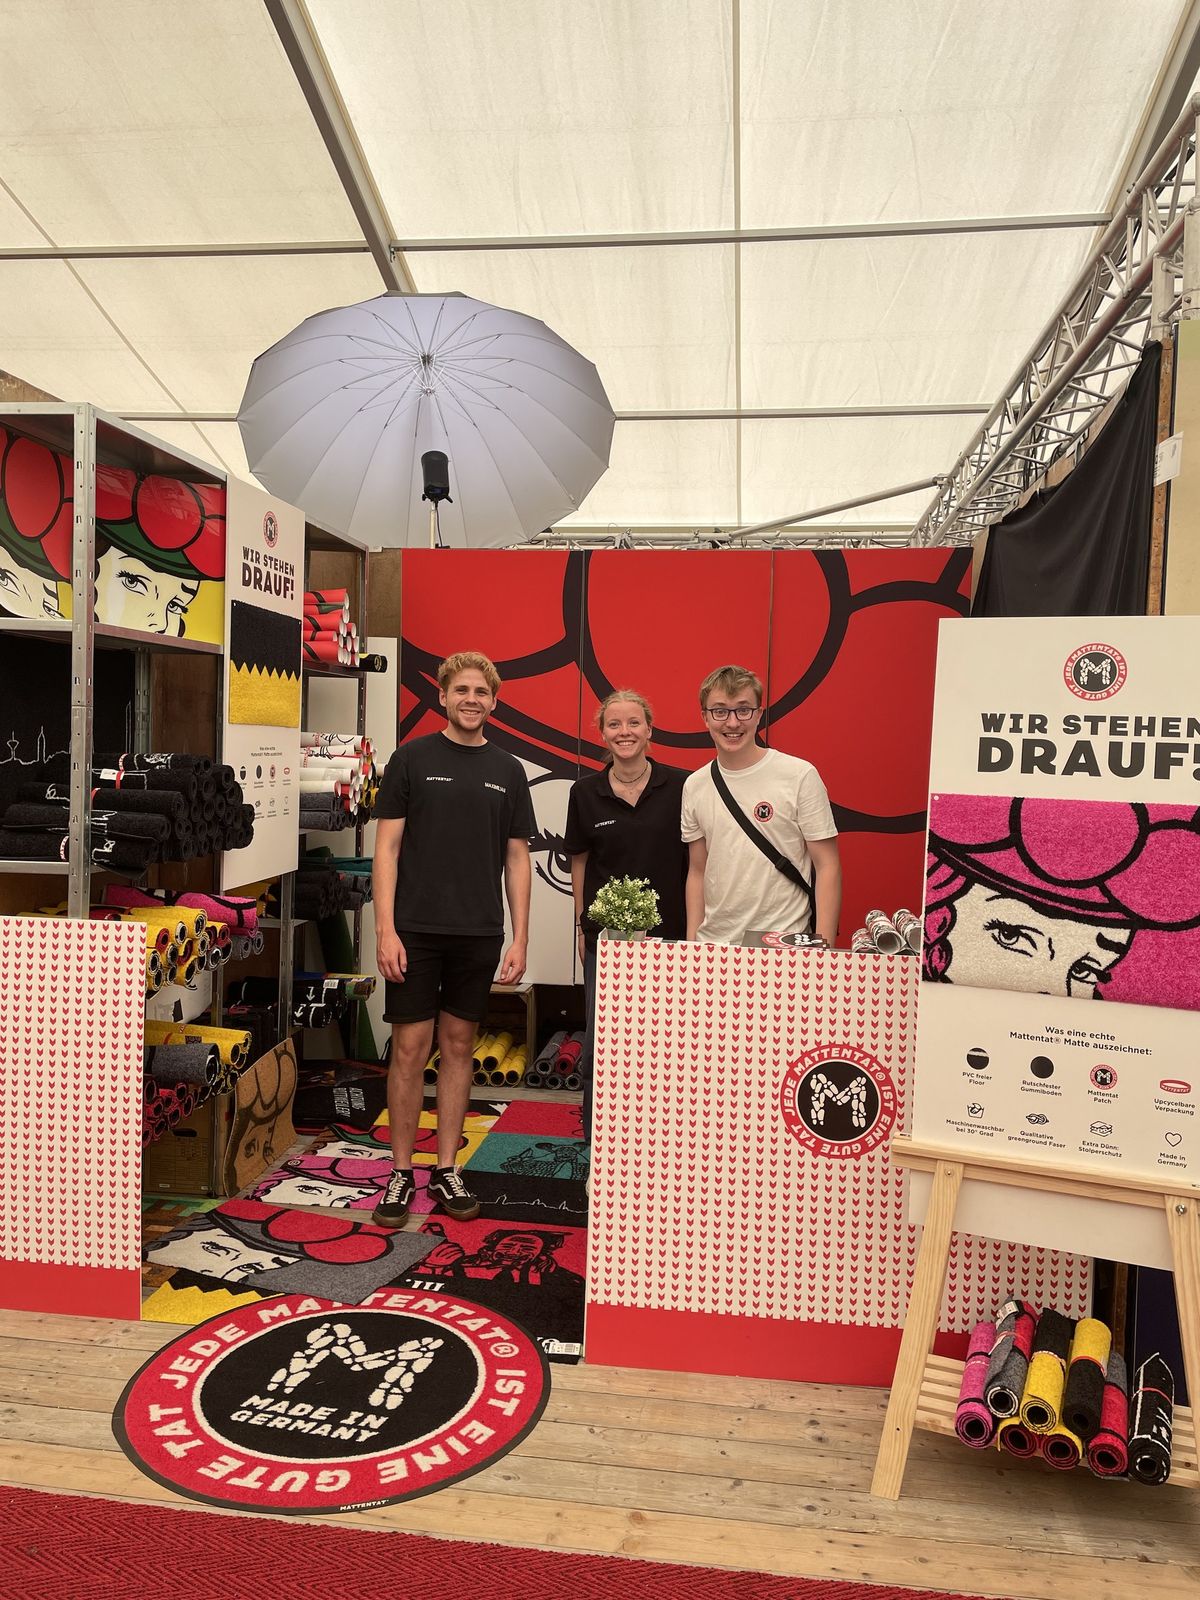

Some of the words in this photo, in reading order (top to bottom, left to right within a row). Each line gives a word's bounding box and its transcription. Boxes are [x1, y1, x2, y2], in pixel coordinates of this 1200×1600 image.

[242, 546, 261, 565] WIR
[263, 554, 295, 577] STEHEN
[241, 562, 295, 600] DRAUF!
[1064, 660, 1074, 681] JEDE
[1068, 684, 1084, 696] TAT
[981, 713, 1048, 734] WIR
[1045, 1026, 1065, 1035] Was
[1067, 1028, 1087, 1037] eine
[1089, 1031, 1116, 1041] echte
[1063, 1038, 1090, 1048] Matte
[1092, 1043, 1152, 1056] auszeichnet:
[962, 1071, 975, 1079] PVC
[975, 1073, 993, 1081] freier
[968, 1078, 985, 1086] Floor
[1020, 1086, 1063, 1097] Gummiboden
[1022, 1080, 1061, 1090] Rutschfester
[783, 1077, 798, 1116] JEDE
[880, 1085, 894, 1111] IST
[1087, 1089, 1119, 1099] Mattentat
[1093, 1097, 1112, 1105] Patch
[1154, 1098, 1196, 1109] Upcycelbare
[1154, 1105, 1195, 1116] Verpackung
[864, 1113, 892, 1147] EINE
[945, 1119, 1005, 1133] Maschinenwaschbar
[955, 1126, 966, 1134] bei
[979, 1130, 994, 1138] Grad
[790, 1124, 817, 1148] TAT
[1007, 1135, 1048, 1146] greenground
[1048, 1140, 1066, 1148] Faser
[1020, 1130, 1054, 1141] Qualitative
[821, 1143, 862, 1156] GUTE
[1082, 1140, 1099, 1148] Extra
[1078, 1146, 1123, 1158] Stolperschutz
[1159, 1152, 1178, 1160] Made
[1157, 1158, 1188, 1169] Germany
[256, 1292, 520, 1358] MATENTAT®
[160, 1322, 248, 1390] JEDE
[488, 1369, 527, 1417] IST
[239, 1395, 339, 1421] MADE
[339, 1411, 390, 1430] IN
[148, 1404, 205, 1460] TAT
[229, 1409, 380, 1443] GERMANY
[376, 1419, 496, 1485] EINE
[196, 1454, 352, 1493] GUTE
